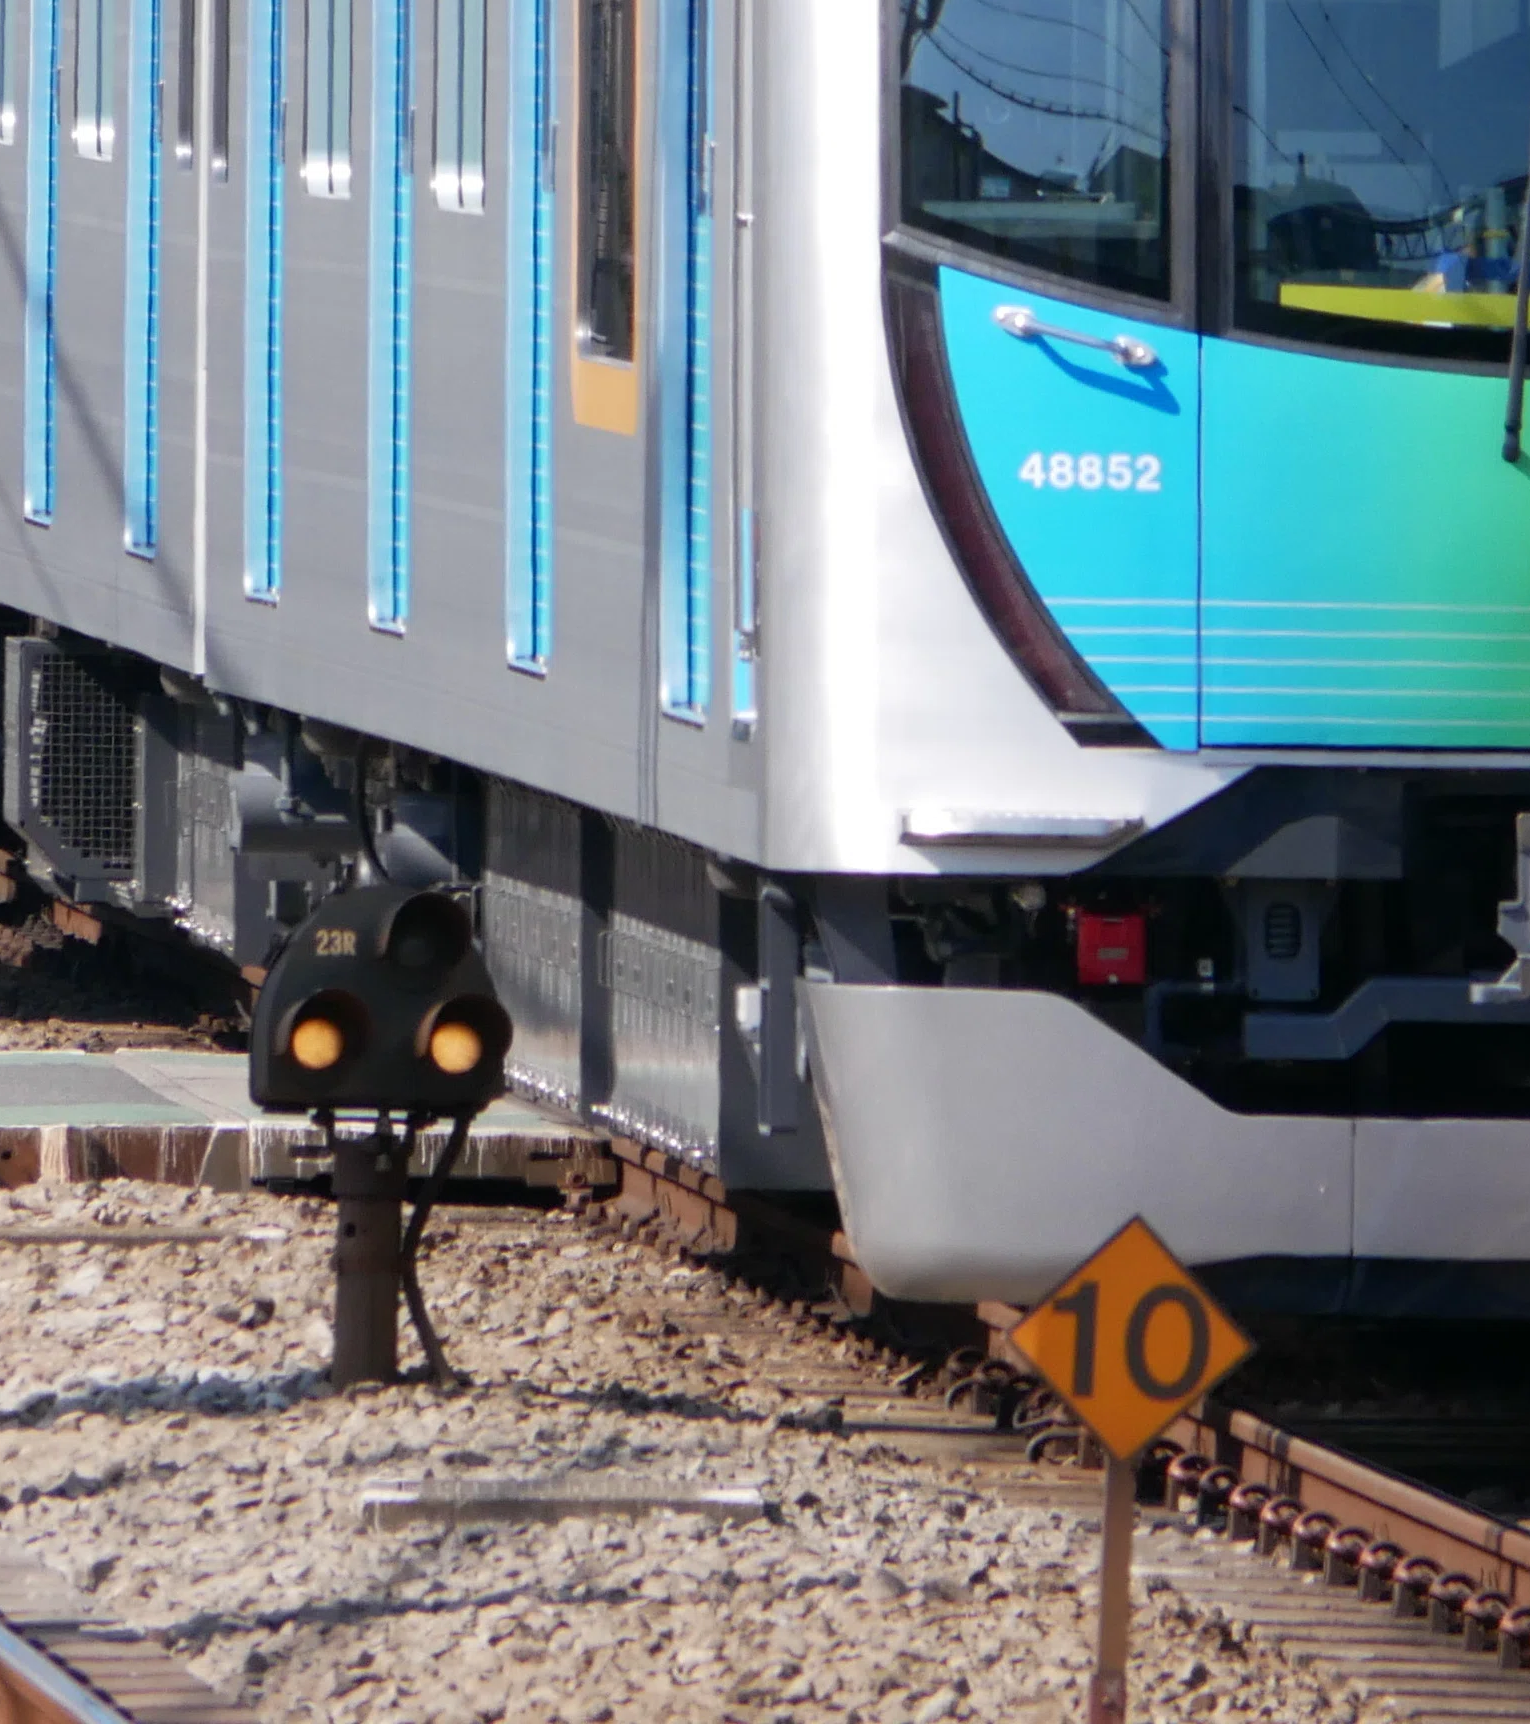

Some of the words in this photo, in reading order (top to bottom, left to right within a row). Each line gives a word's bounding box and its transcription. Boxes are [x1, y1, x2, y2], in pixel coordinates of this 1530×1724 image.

[1019, 451, 1162, 492] 48852
[315, 928, 357, 956] 23R
[1052, 1280, 1211, 1401] 10
